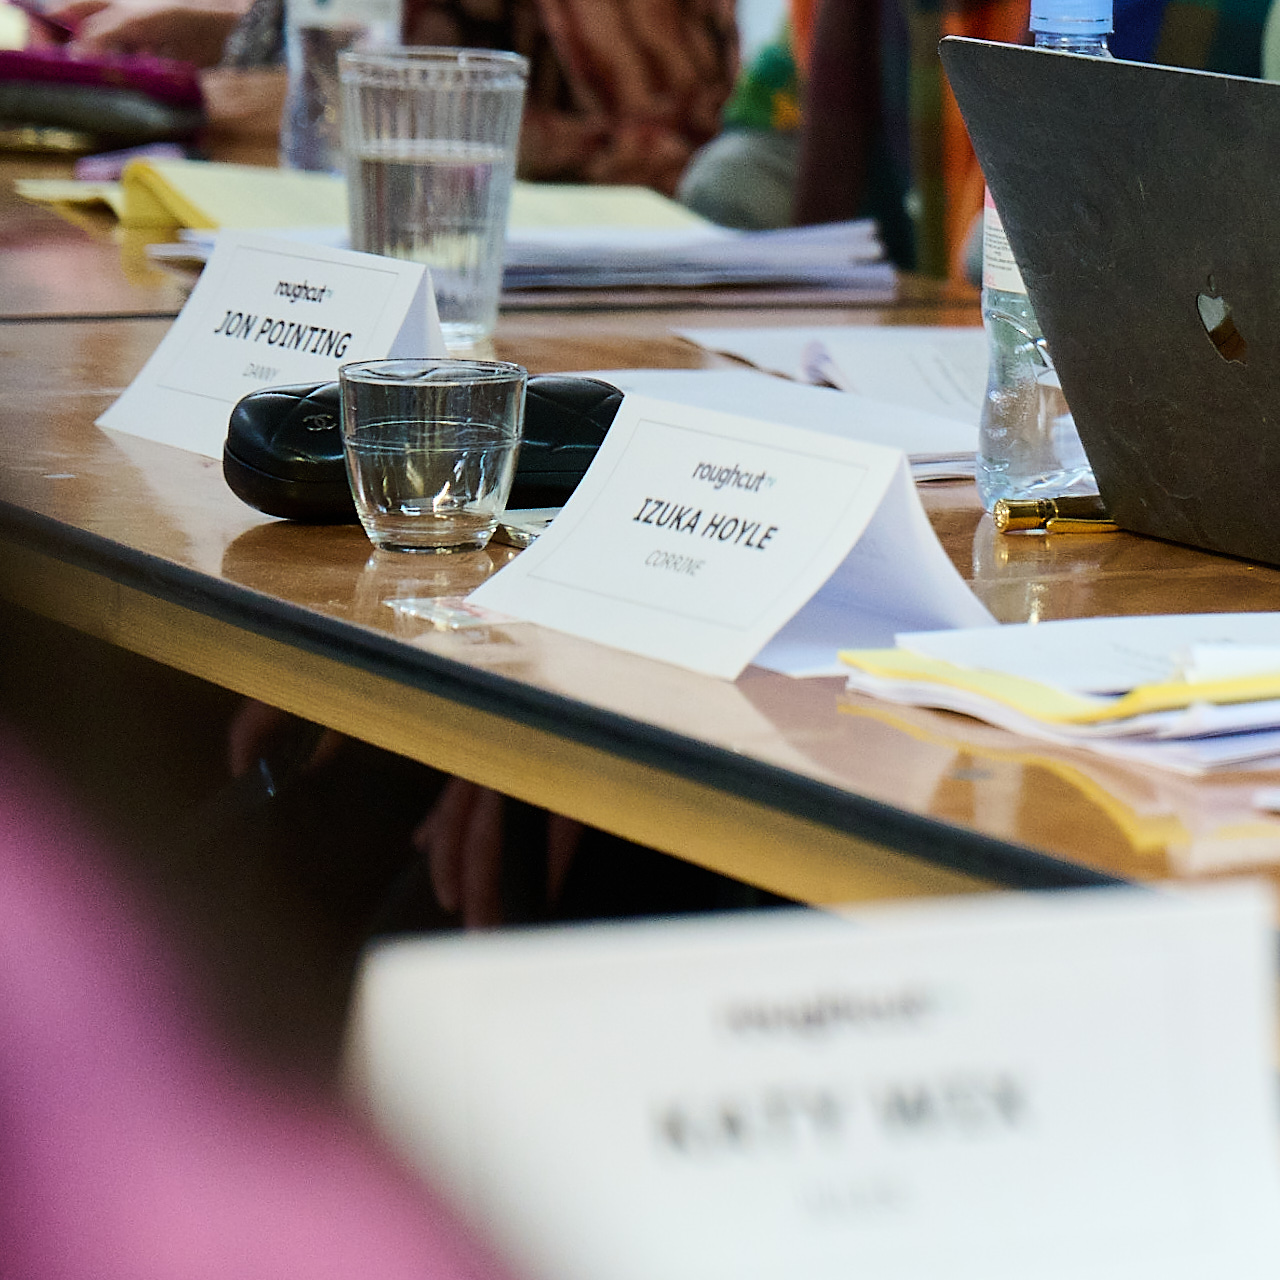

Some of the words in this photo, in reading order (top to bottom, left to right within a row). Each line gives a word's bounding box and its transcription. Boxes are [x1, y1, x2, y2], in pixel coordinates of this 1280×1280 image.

[275, 281, 326, 303] roughcut
[214, 311, 258, 340] JON
[256, 318, 352, 358] POINTING
[692, 462, 766, 492] roughcut
[632, 497, 703, 534] IZUKA
[701, 513, 778, 549] HOYLE
[644, 550, 706, 576] CORRINE
